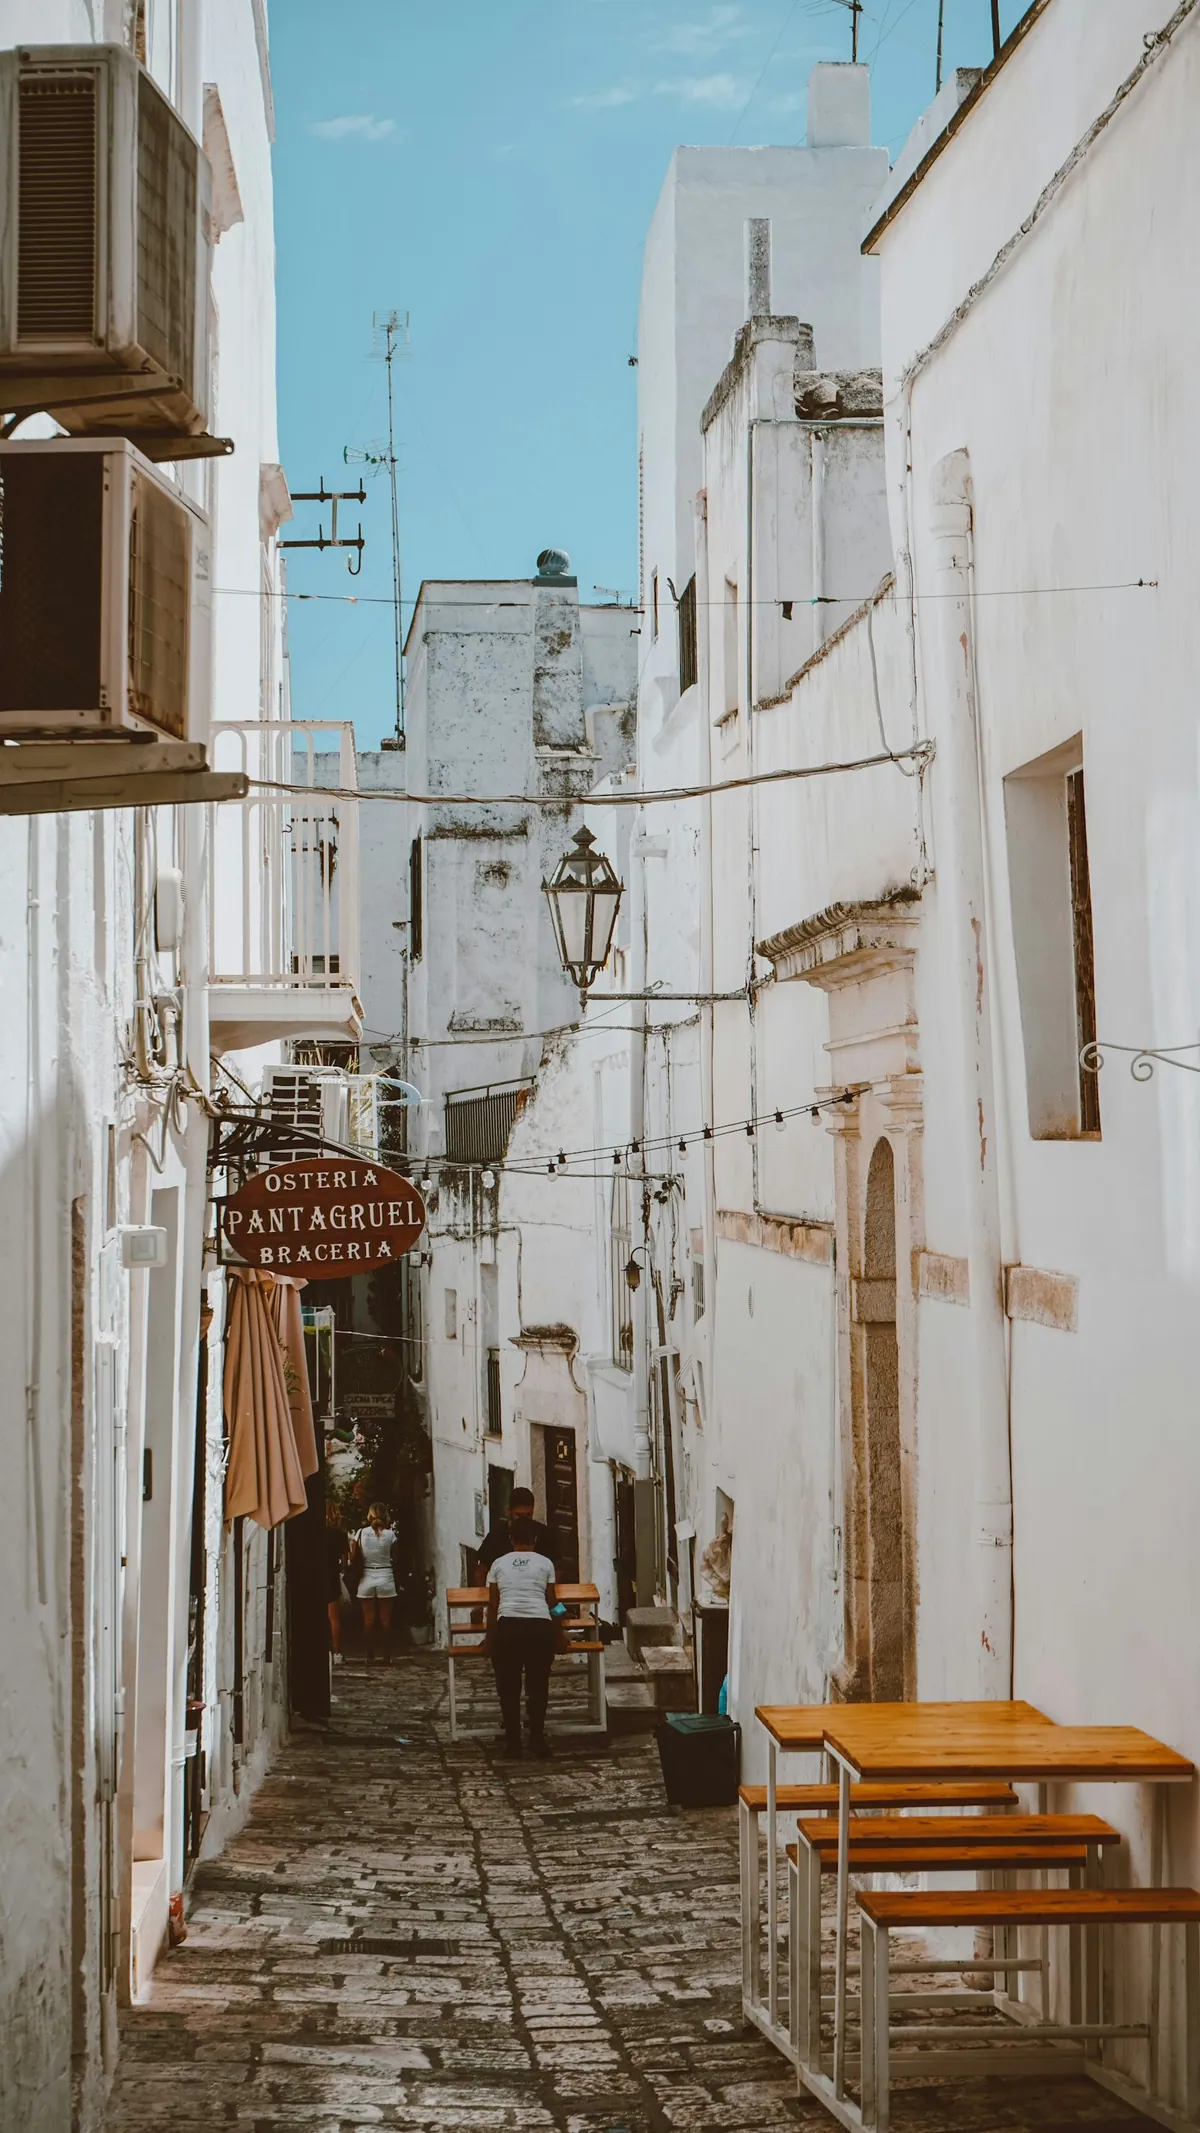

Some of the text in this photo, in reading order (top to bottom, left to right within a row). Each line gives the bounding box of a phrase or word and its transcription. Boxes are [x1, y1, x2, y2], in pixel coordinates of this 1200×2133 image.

[265, 1169, 378, 1192] OSTERIA
[228, 1201, 422, 1235] PANTAGRUEL
[260, 1240, 392, 1264] BRACERIA
